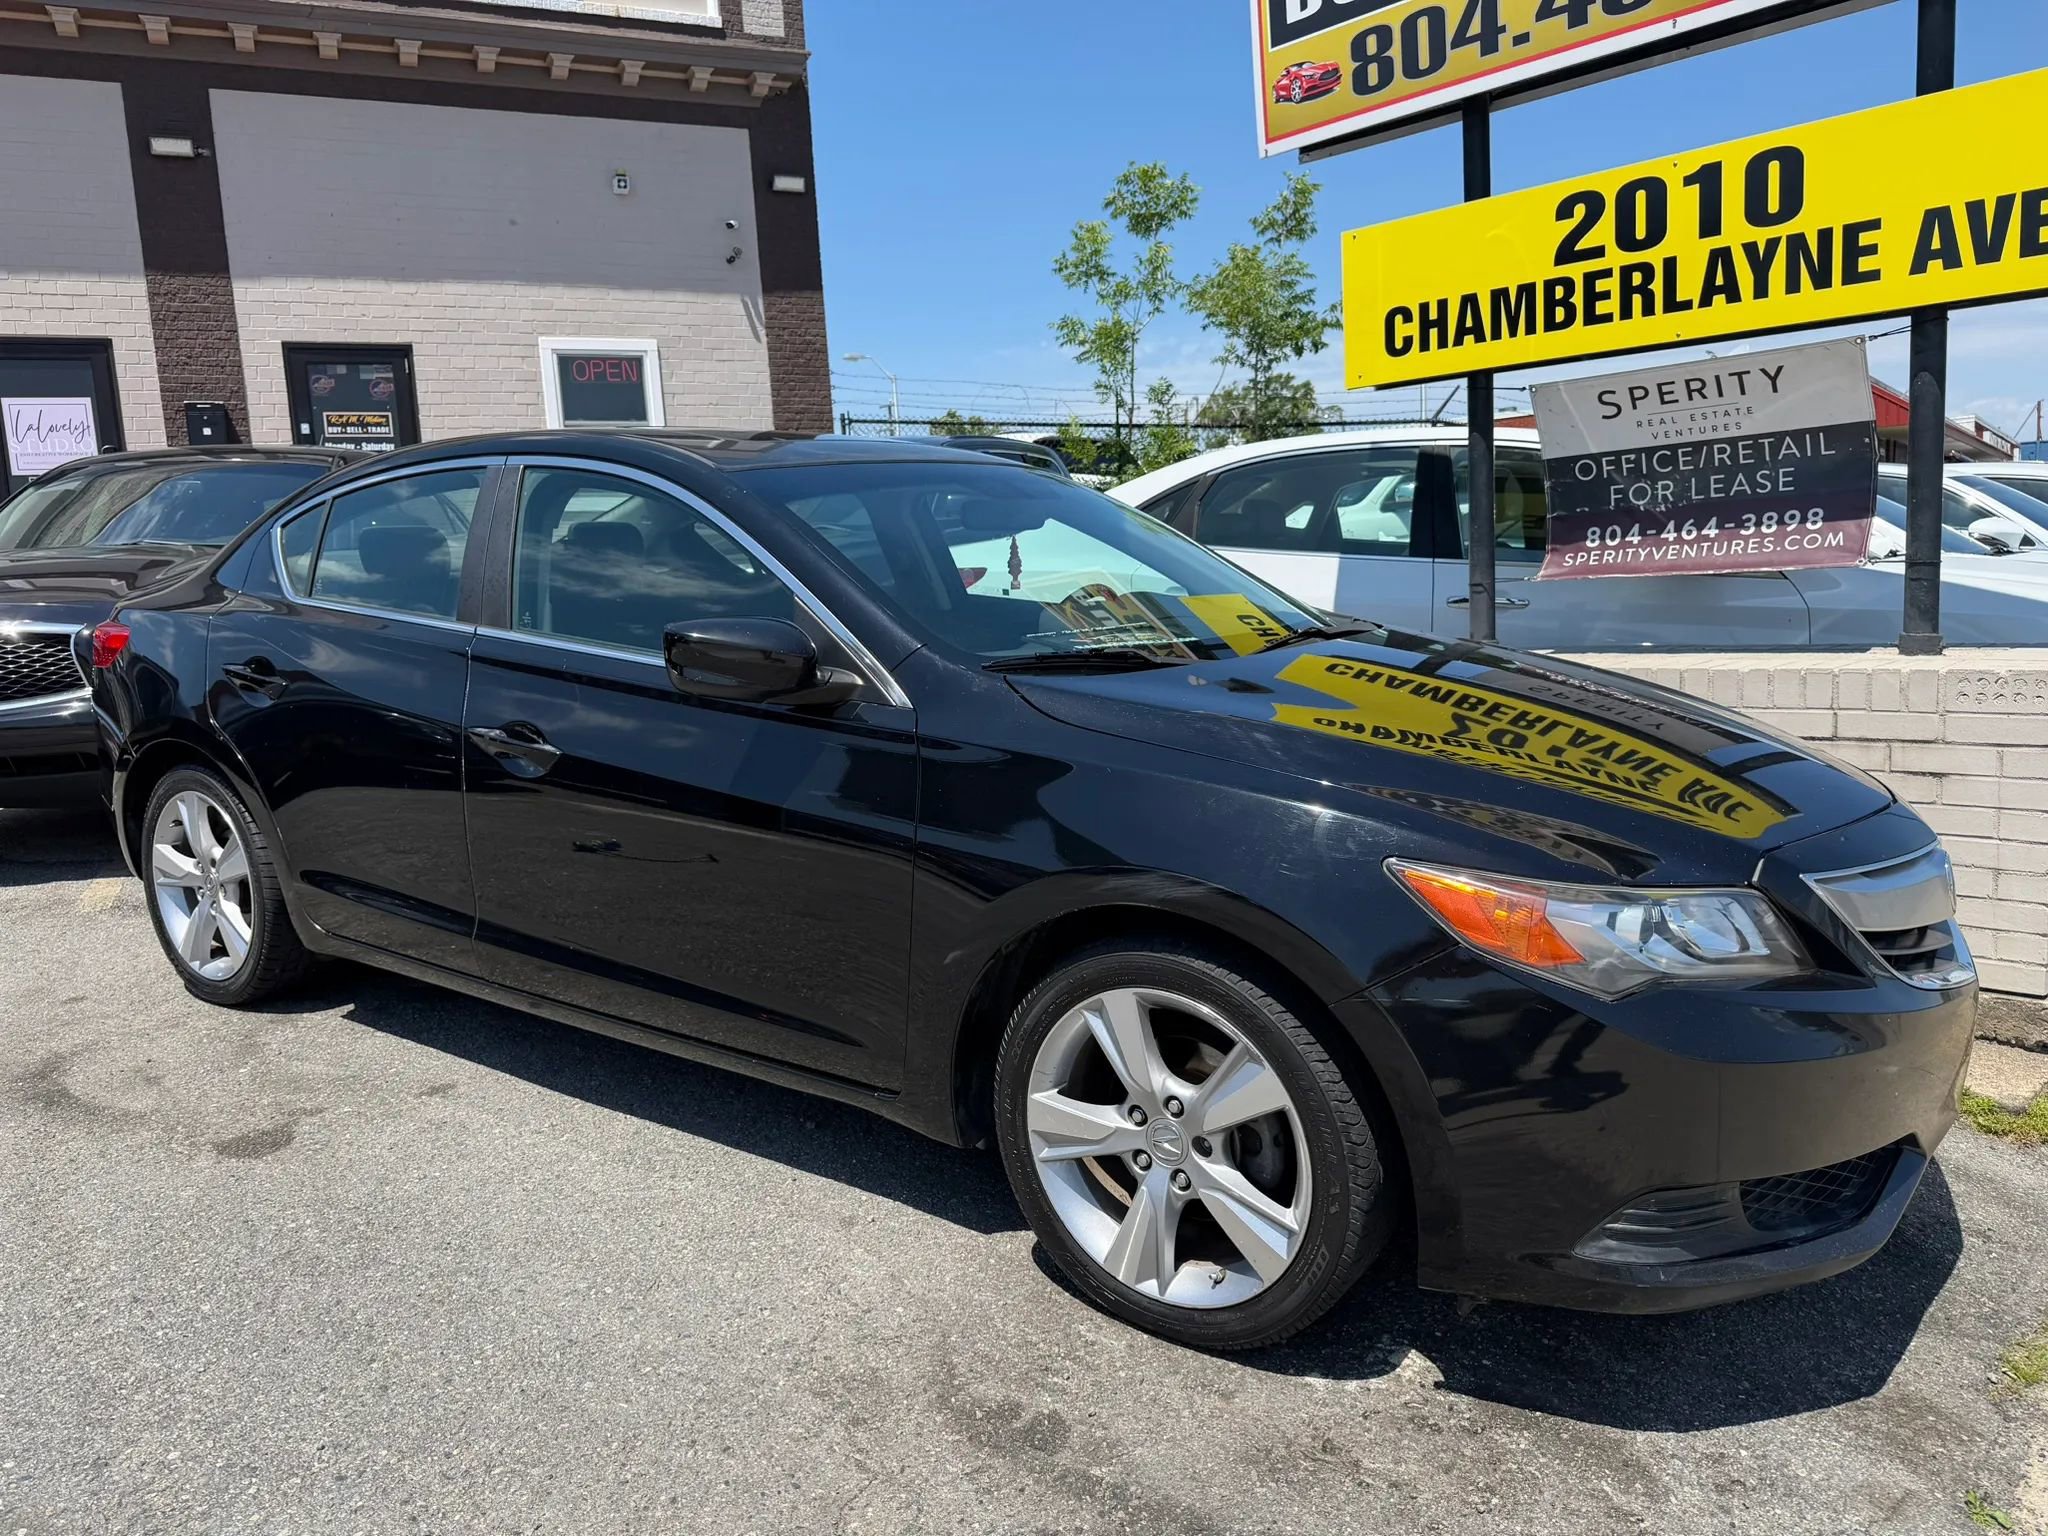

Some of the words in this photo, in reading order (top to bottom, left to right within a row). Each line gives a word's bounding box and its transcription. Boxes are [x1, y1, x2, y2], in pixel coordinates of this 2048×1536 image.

[1350, 0, 1650, 97] 804.
[1554, 145, 1805, 267] 2010
[1384, 217, 1882, 358] CHAMBERLAYNE
[1908, 186, 2048, 276] AVE
[572, 359, 638, 382] OPEN
[1597, 365, 1785, 420] SPERITY
[1636, 415, 1678, 429] REAL
[1690, 406, 1755, 423] ESTATE
[1651, 421, 1743, 441] VENTURES
[10, 438, 95, 453] STUDIO
[361, 441, 395, 451] Saturday
[1574, 431, 1836, 482] OFFICE/RETAIL
[1610, 480, 1674, 507] FOR
[1691, 467, 1796, 500] LEASE
[1585, 507, 1825, 548] 804-464-3898
[1563, 530, 1844, 567] SPERITYVENTURES.COM
